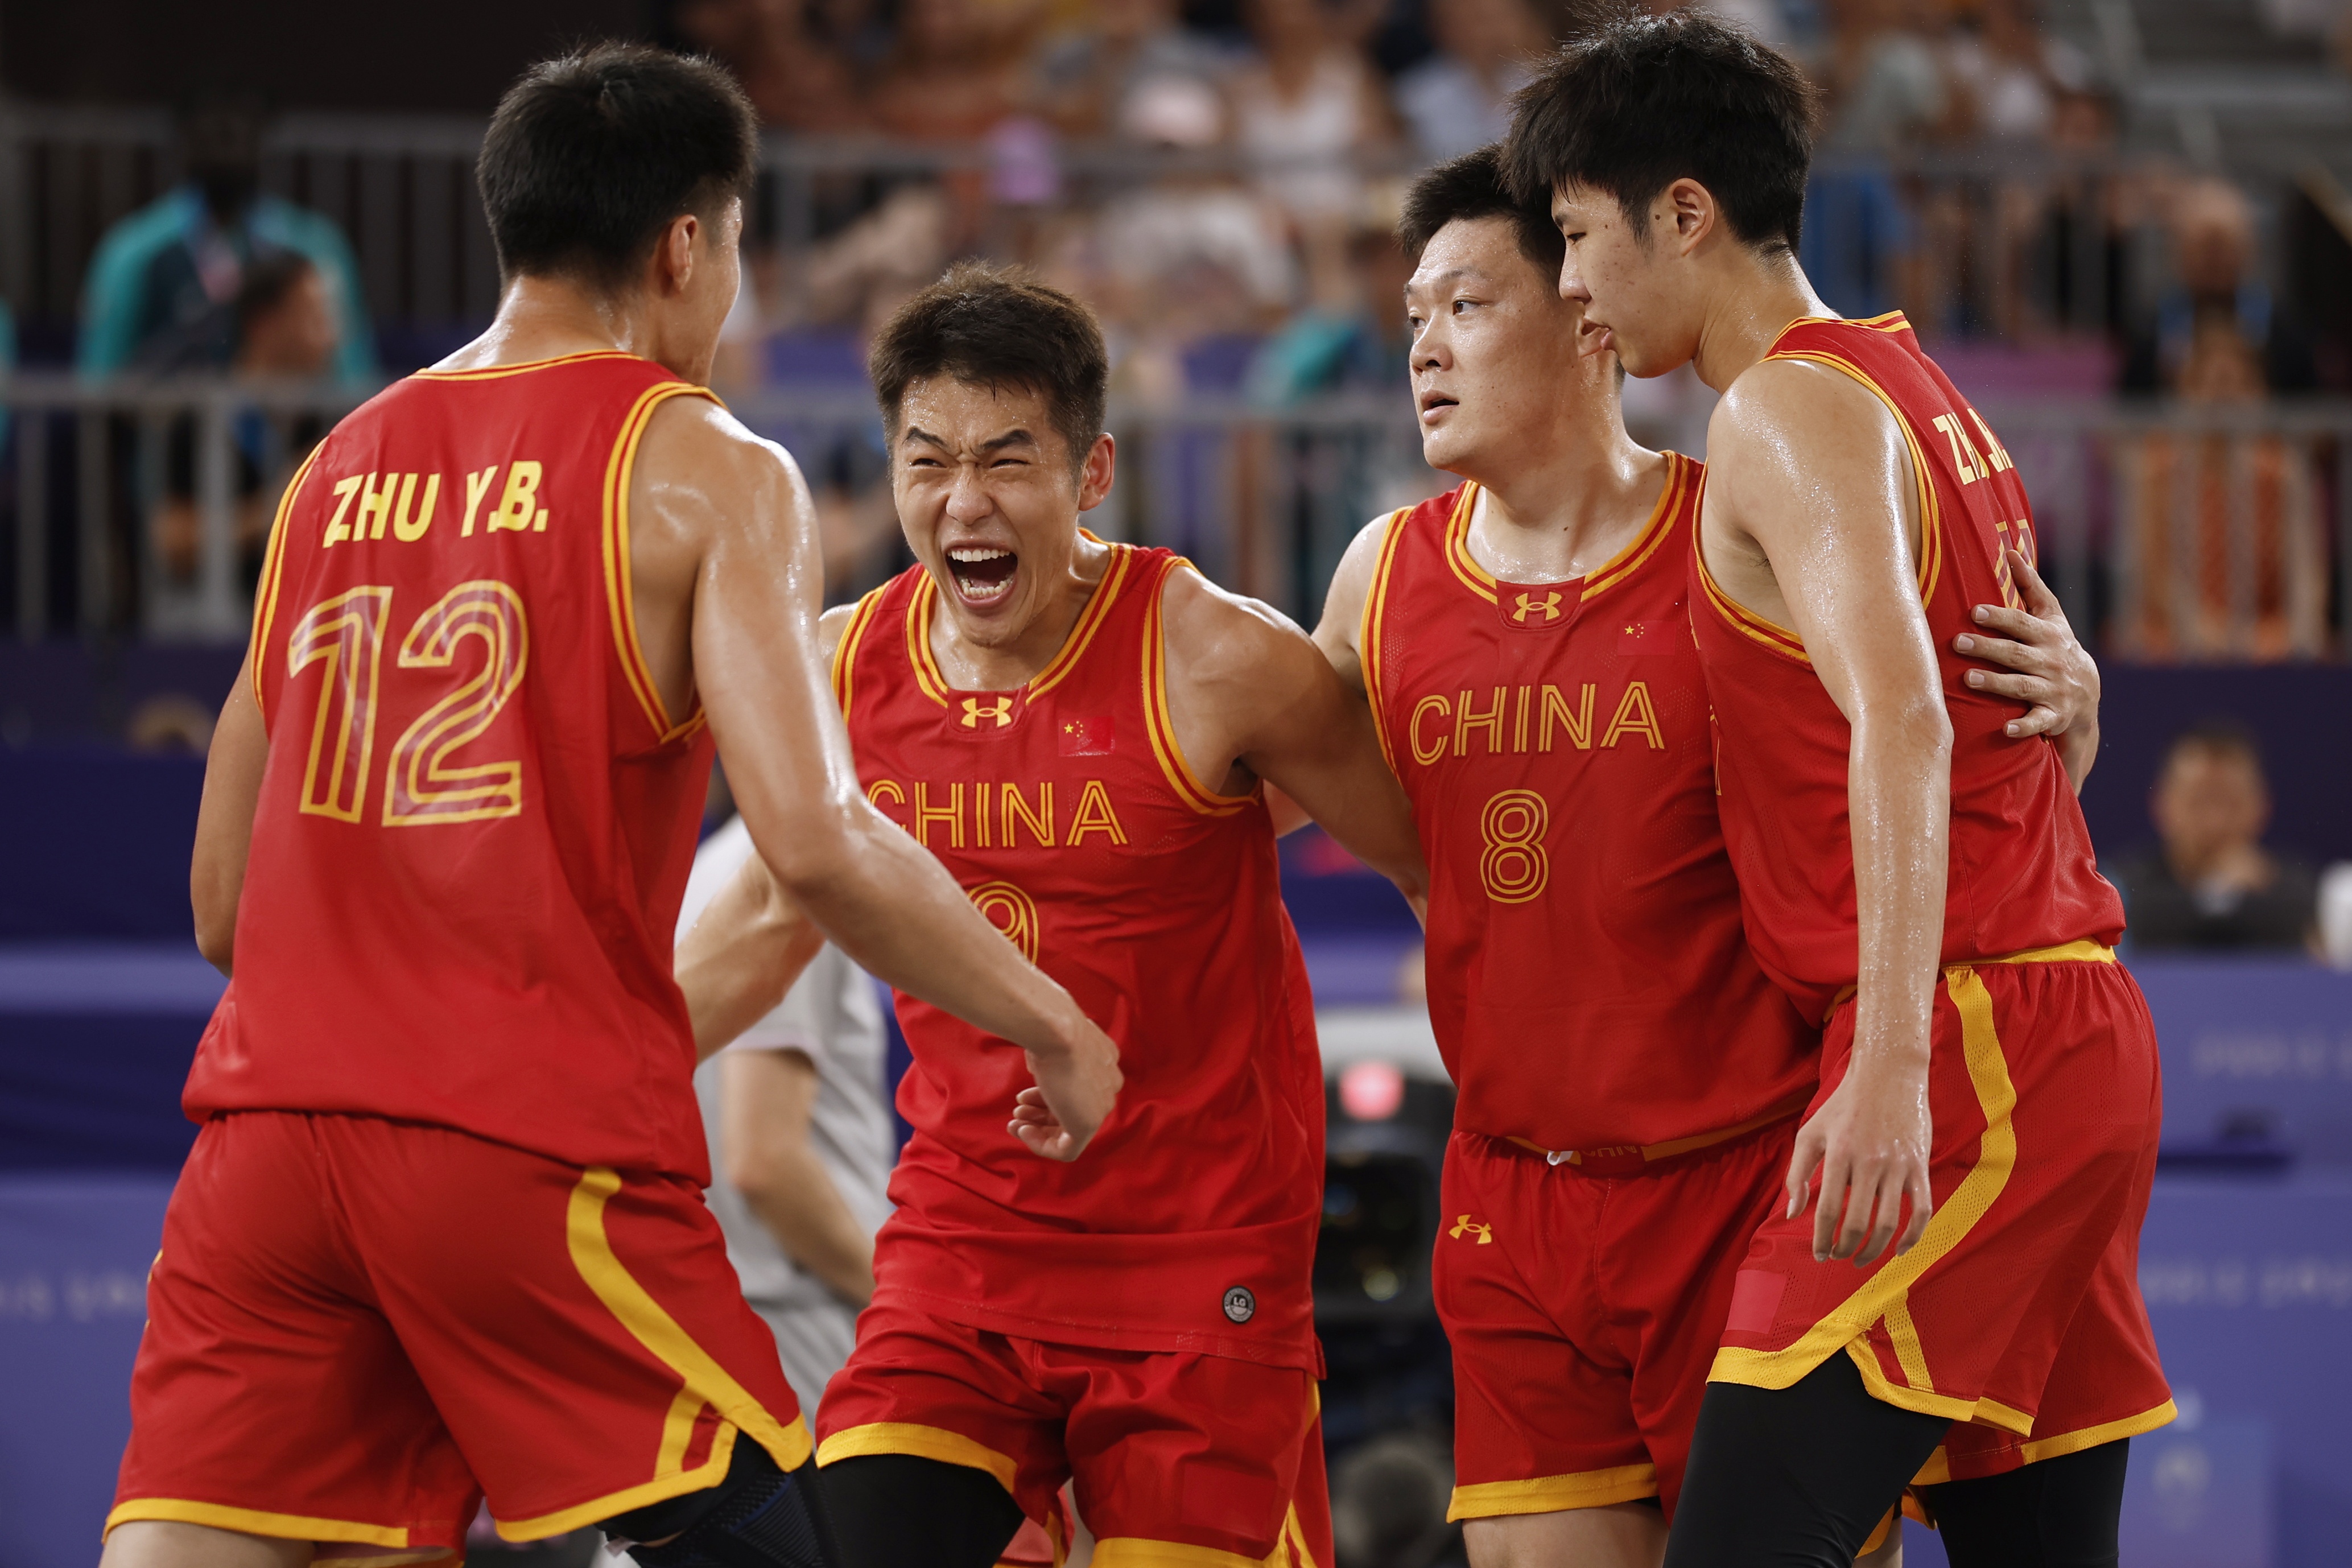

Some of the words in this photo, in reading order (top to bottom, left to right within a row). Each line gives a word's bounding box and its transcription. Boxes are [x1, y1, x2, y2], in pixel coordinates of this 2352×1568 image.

[322, 471, 441, 549] ZHU
[460, 460, 549, 538] Y.B.
[287, 579, 530, 828] 12
[1409, 681, 1665, 766] CHINA
[1480, 789, 1549, 904] 8
